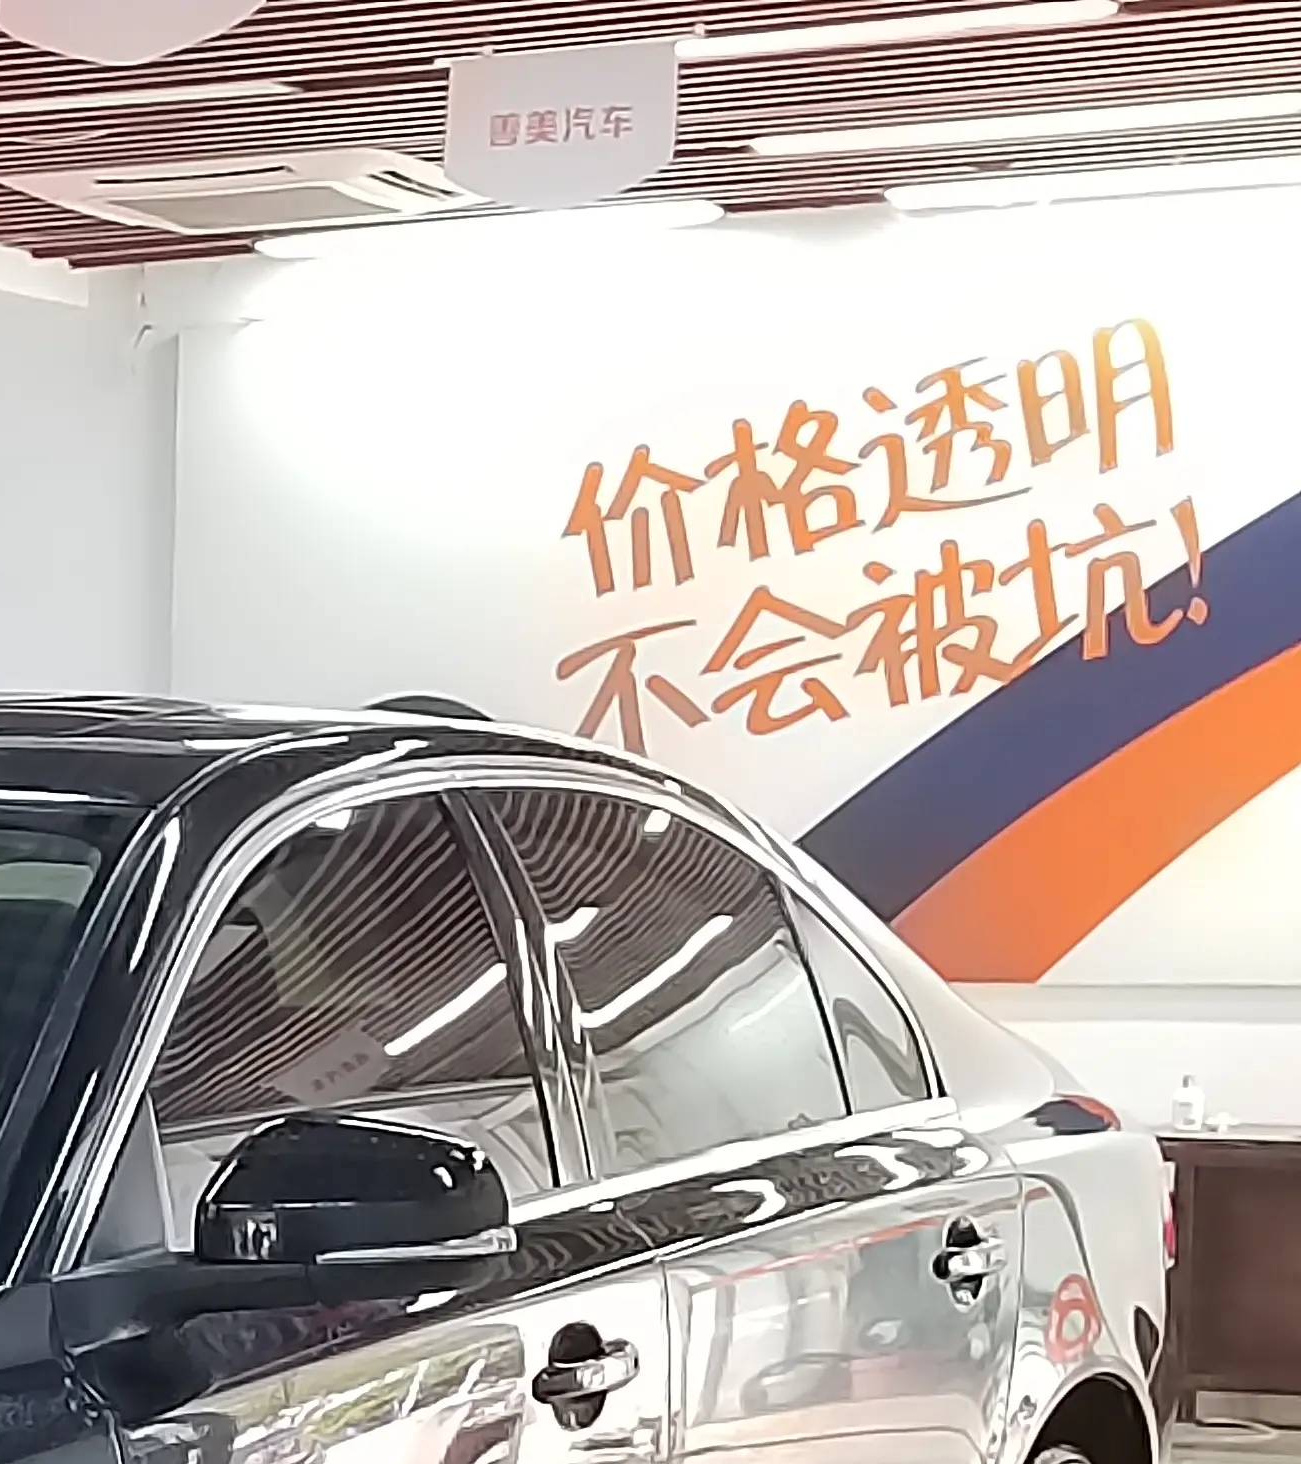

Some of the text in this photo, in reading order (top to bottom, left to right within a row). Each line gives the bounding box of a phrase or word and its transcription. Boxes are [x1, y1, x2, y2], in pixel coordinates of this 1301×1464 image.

[563, 318, 1175, 596] 价格透明
[556, 496, 1208, 758] 不会被坑!
